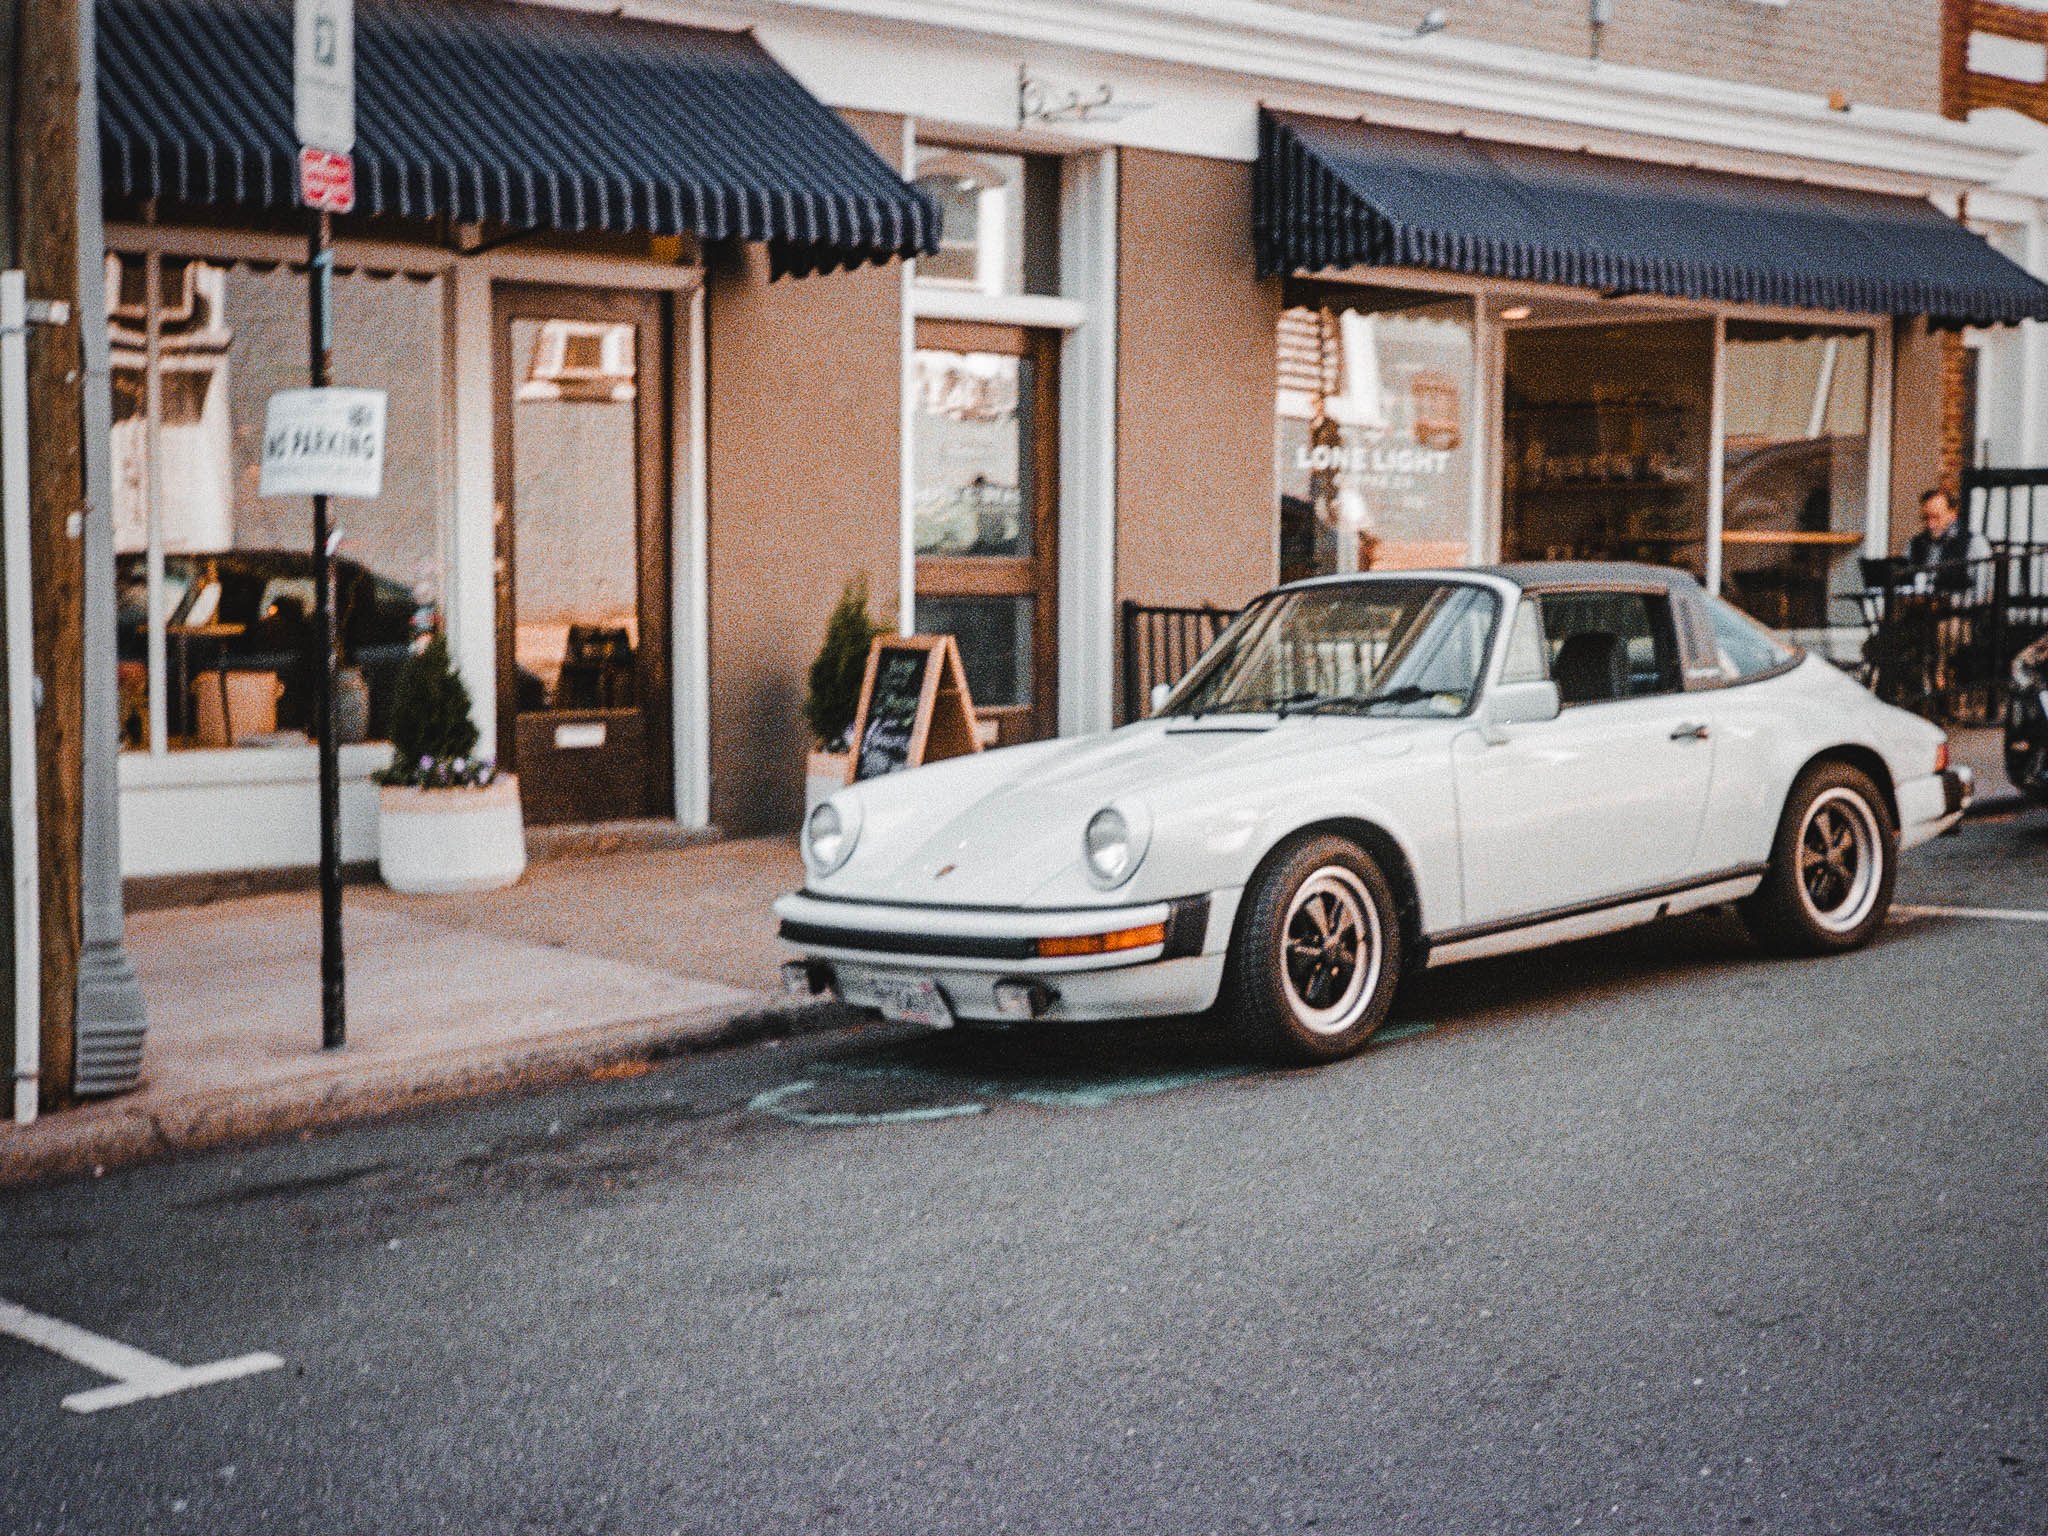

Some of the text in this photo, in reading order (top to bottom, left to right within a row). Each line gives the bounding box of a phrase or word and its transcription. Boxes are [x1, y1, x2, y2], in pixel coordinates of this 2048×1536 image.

[291, 429, 376, 460] PARKING
[1296, 445, 1451, 473] LONE LIGHT
